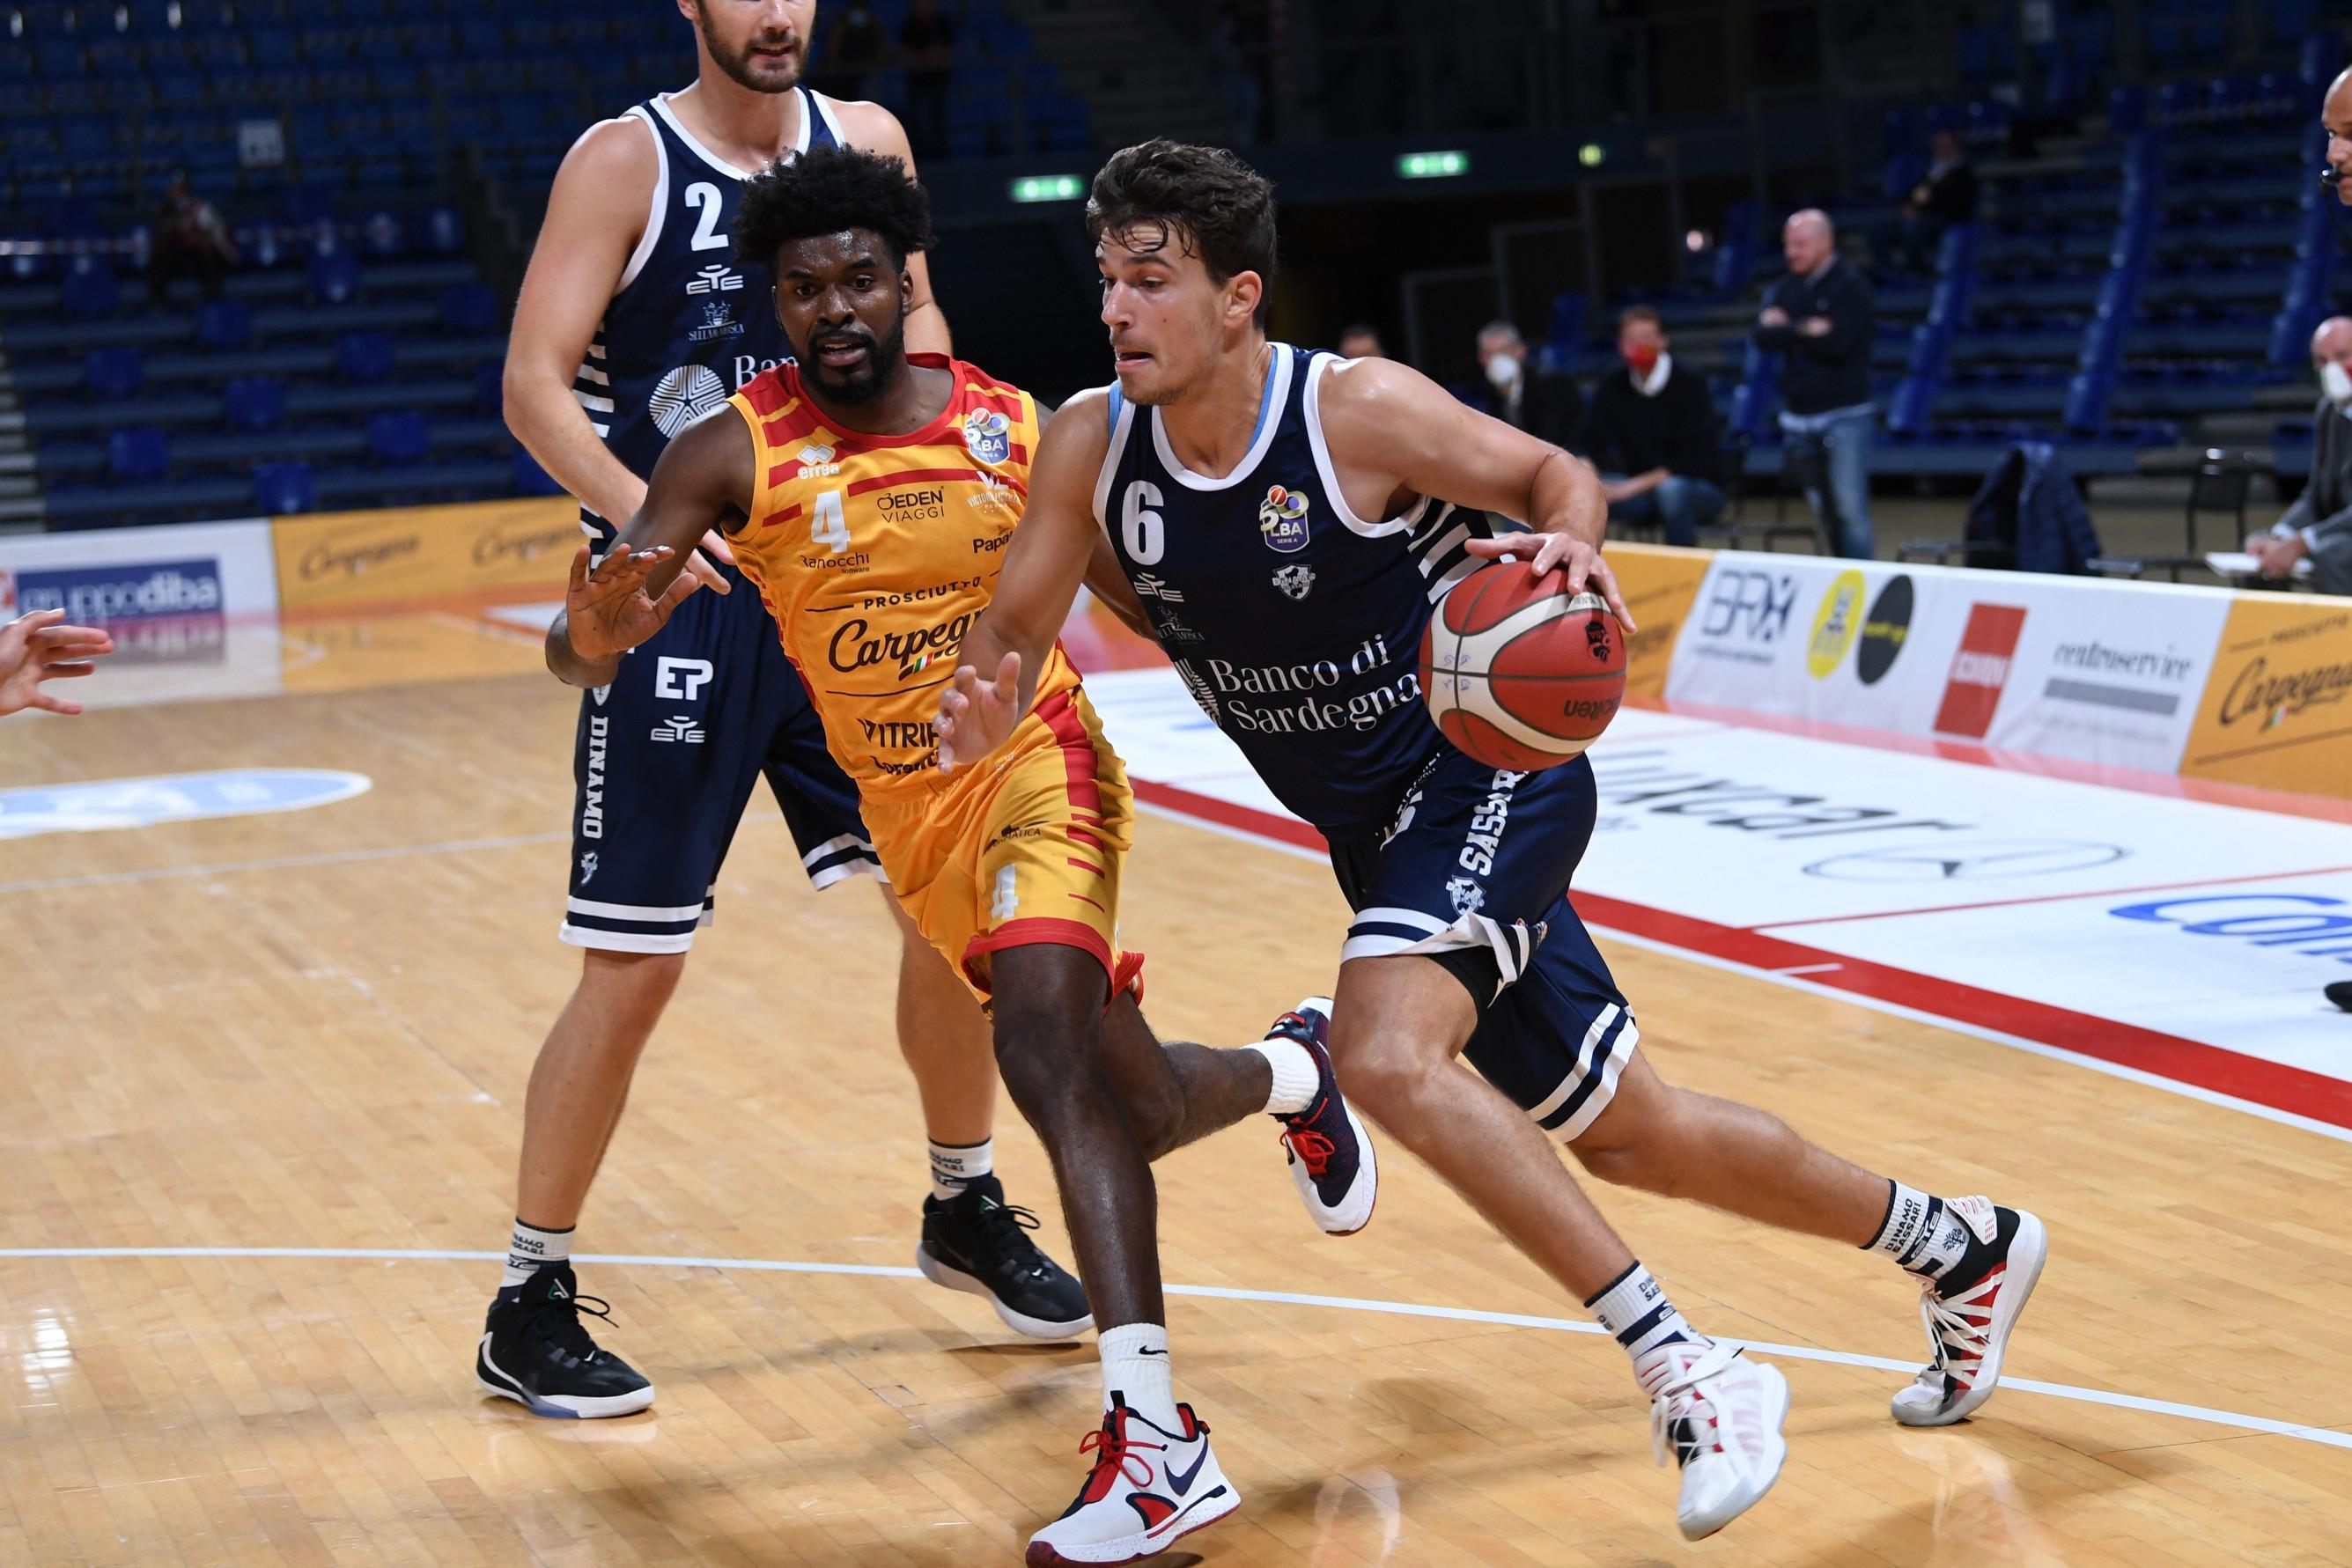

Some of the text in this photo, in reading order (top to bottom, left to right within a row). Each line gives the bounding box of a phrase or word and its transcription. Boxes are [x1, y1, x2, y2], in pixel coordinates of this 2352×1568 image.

[684, 181, 729, 252] 2
[734, 354, 800, 393] Ban
[810, 490, 852, 553] 4
[881, 505, 945, 524] VIAGGI
[1121, 480, 1165, 566] 6
[828, 610, 988, 682] Carpeg
[1205, 633, 1392, 694] Banco di
[1228, 673, 1422, 733] Sardegna
[582, 715, 609, 839] DINAMO
[1458, 769, 1530, 877] SASSAR
[1884, 1197, 1913, 1251] DINAMO
[1892, 1202, 1922, 1254] SASSARI
